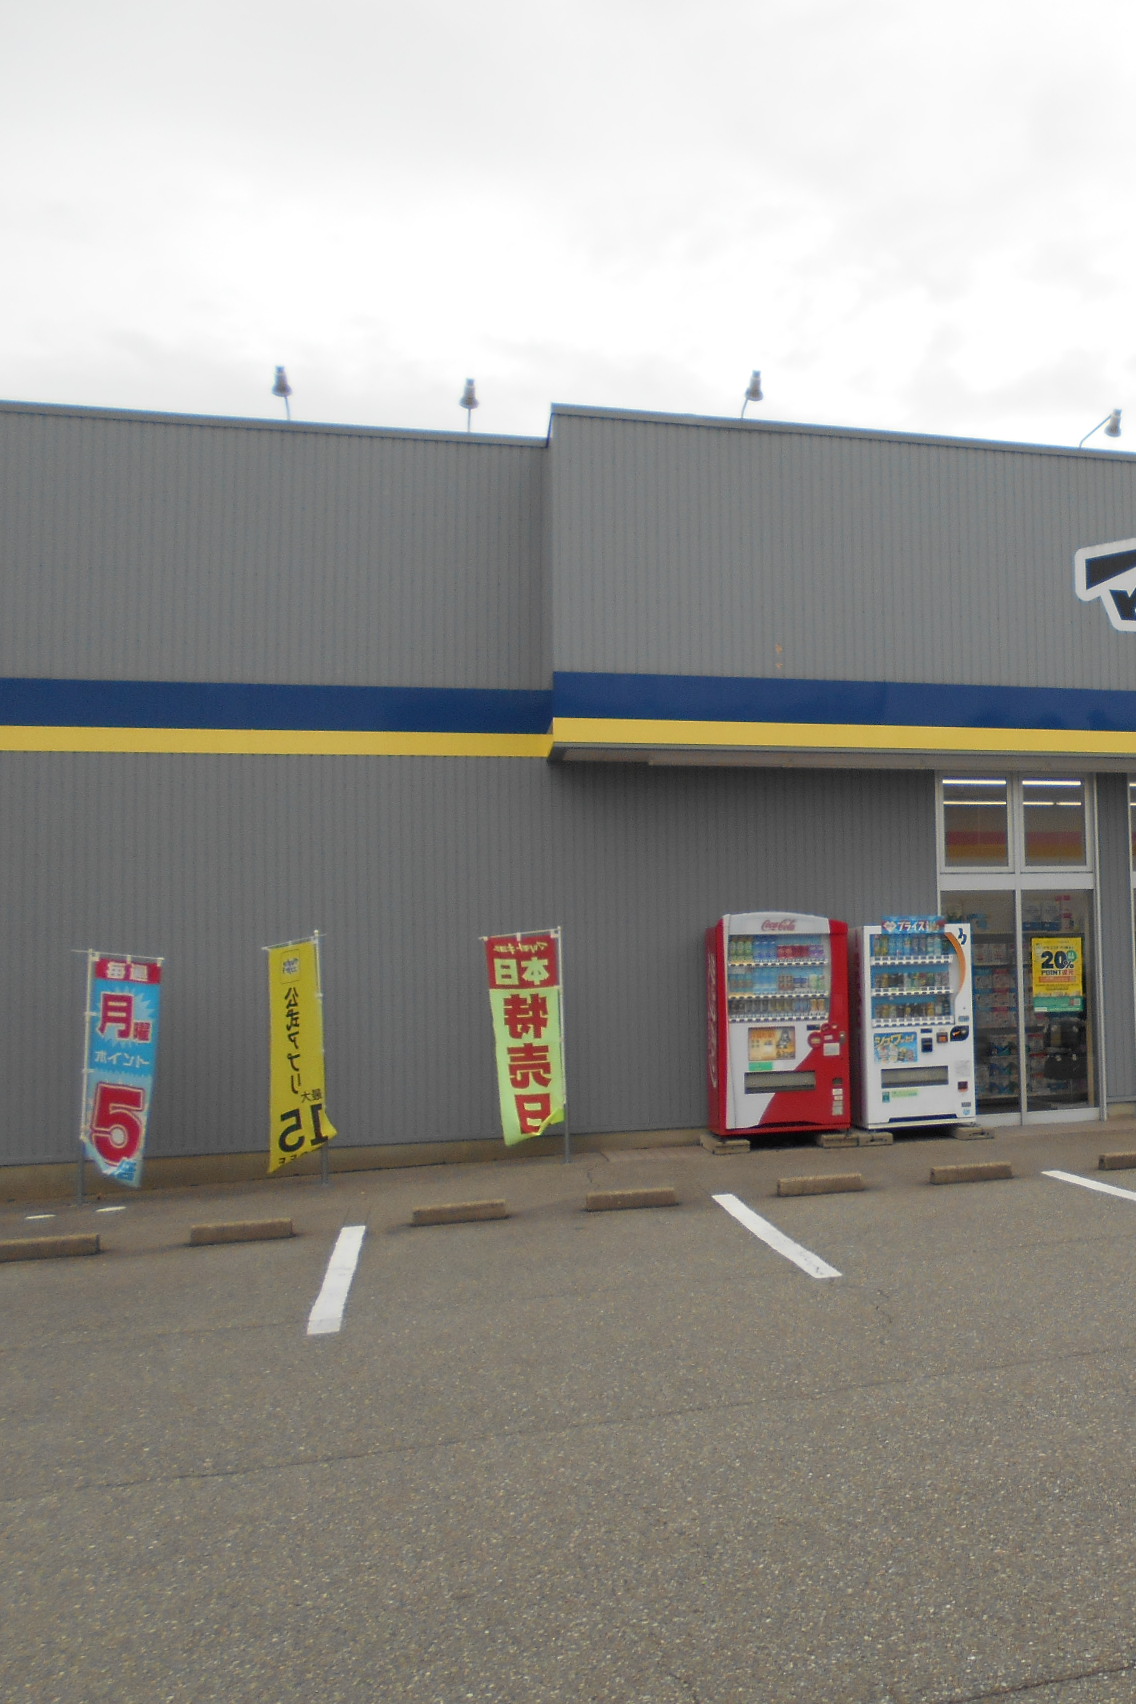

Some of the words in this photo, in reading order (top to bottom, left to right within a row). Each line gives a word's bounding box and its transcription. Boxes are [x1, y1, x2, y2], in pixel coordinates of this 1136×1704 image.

[1041, 950, 1074, 969] 20%
[94, 1050, 150, 1069] ポイント
[91, 1082, 146, 1168] 5
